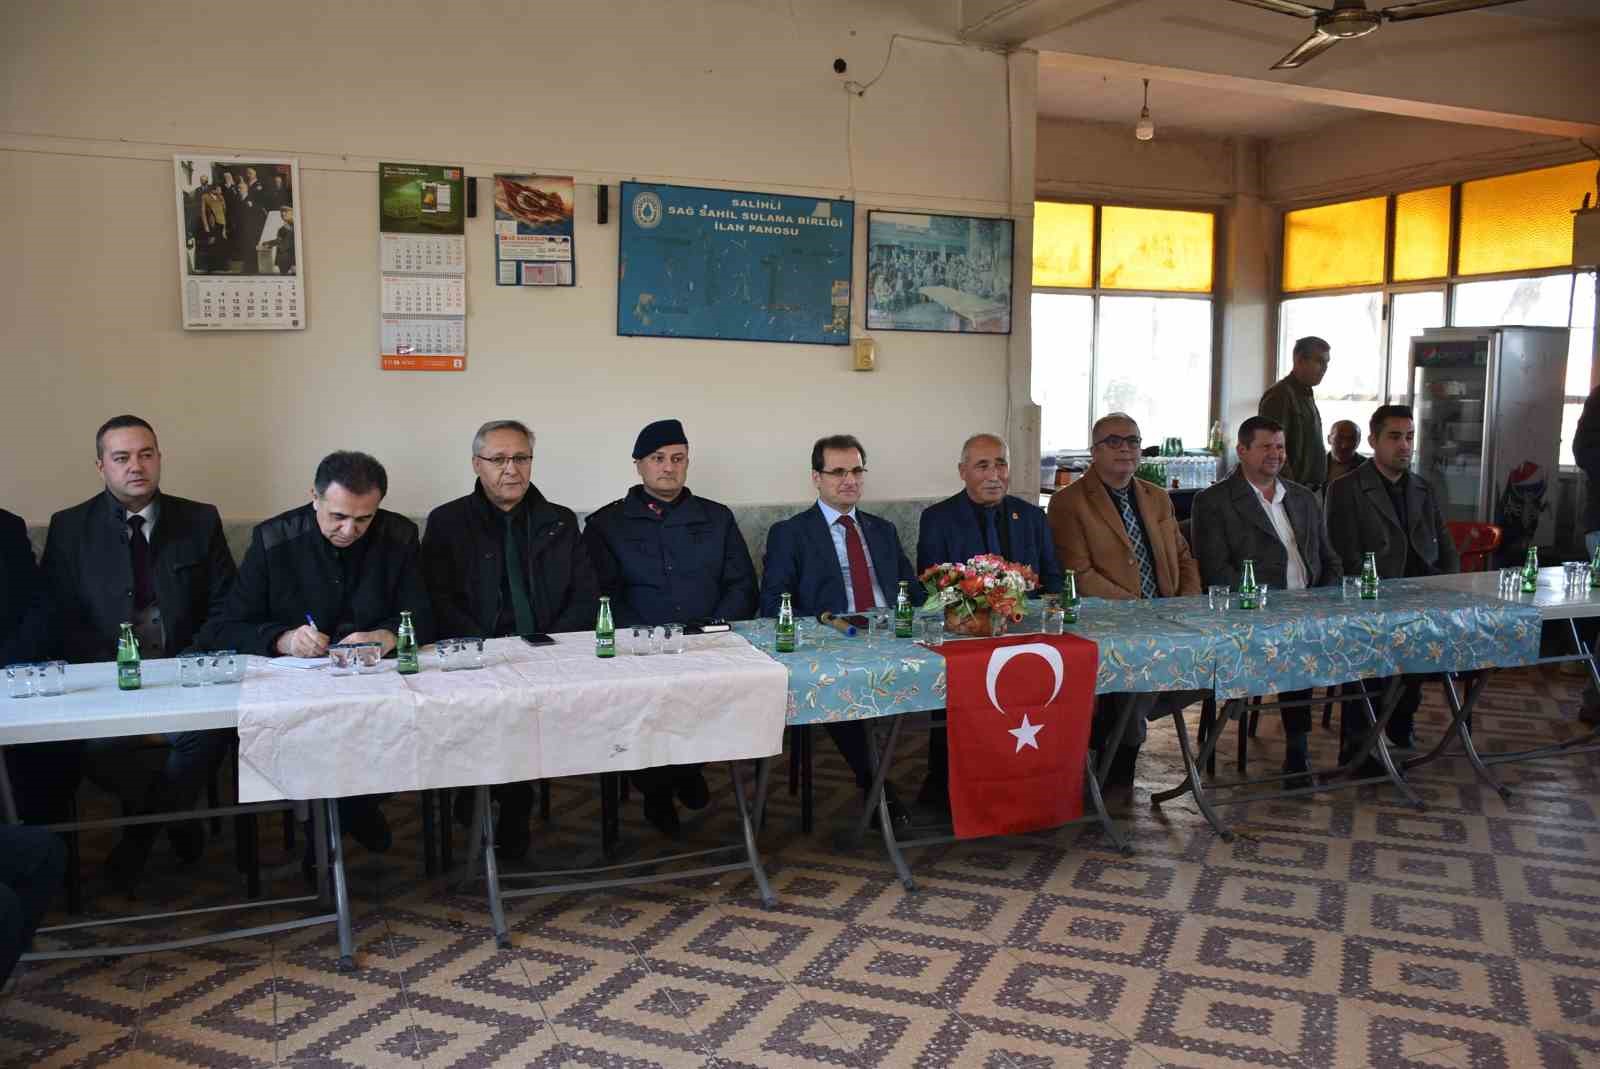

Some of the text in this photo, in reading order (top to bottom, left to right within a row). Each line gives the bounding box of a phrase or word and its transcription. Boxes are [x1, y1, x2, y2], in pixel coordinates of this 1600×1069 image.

[732, 199, 782, 210] SALİHLİ
[667, 206, 843, 228] SAĞ SAHİL SULAMA BİRLİĞİ
[714, 221, 799, 236] İLAN PANOSU
